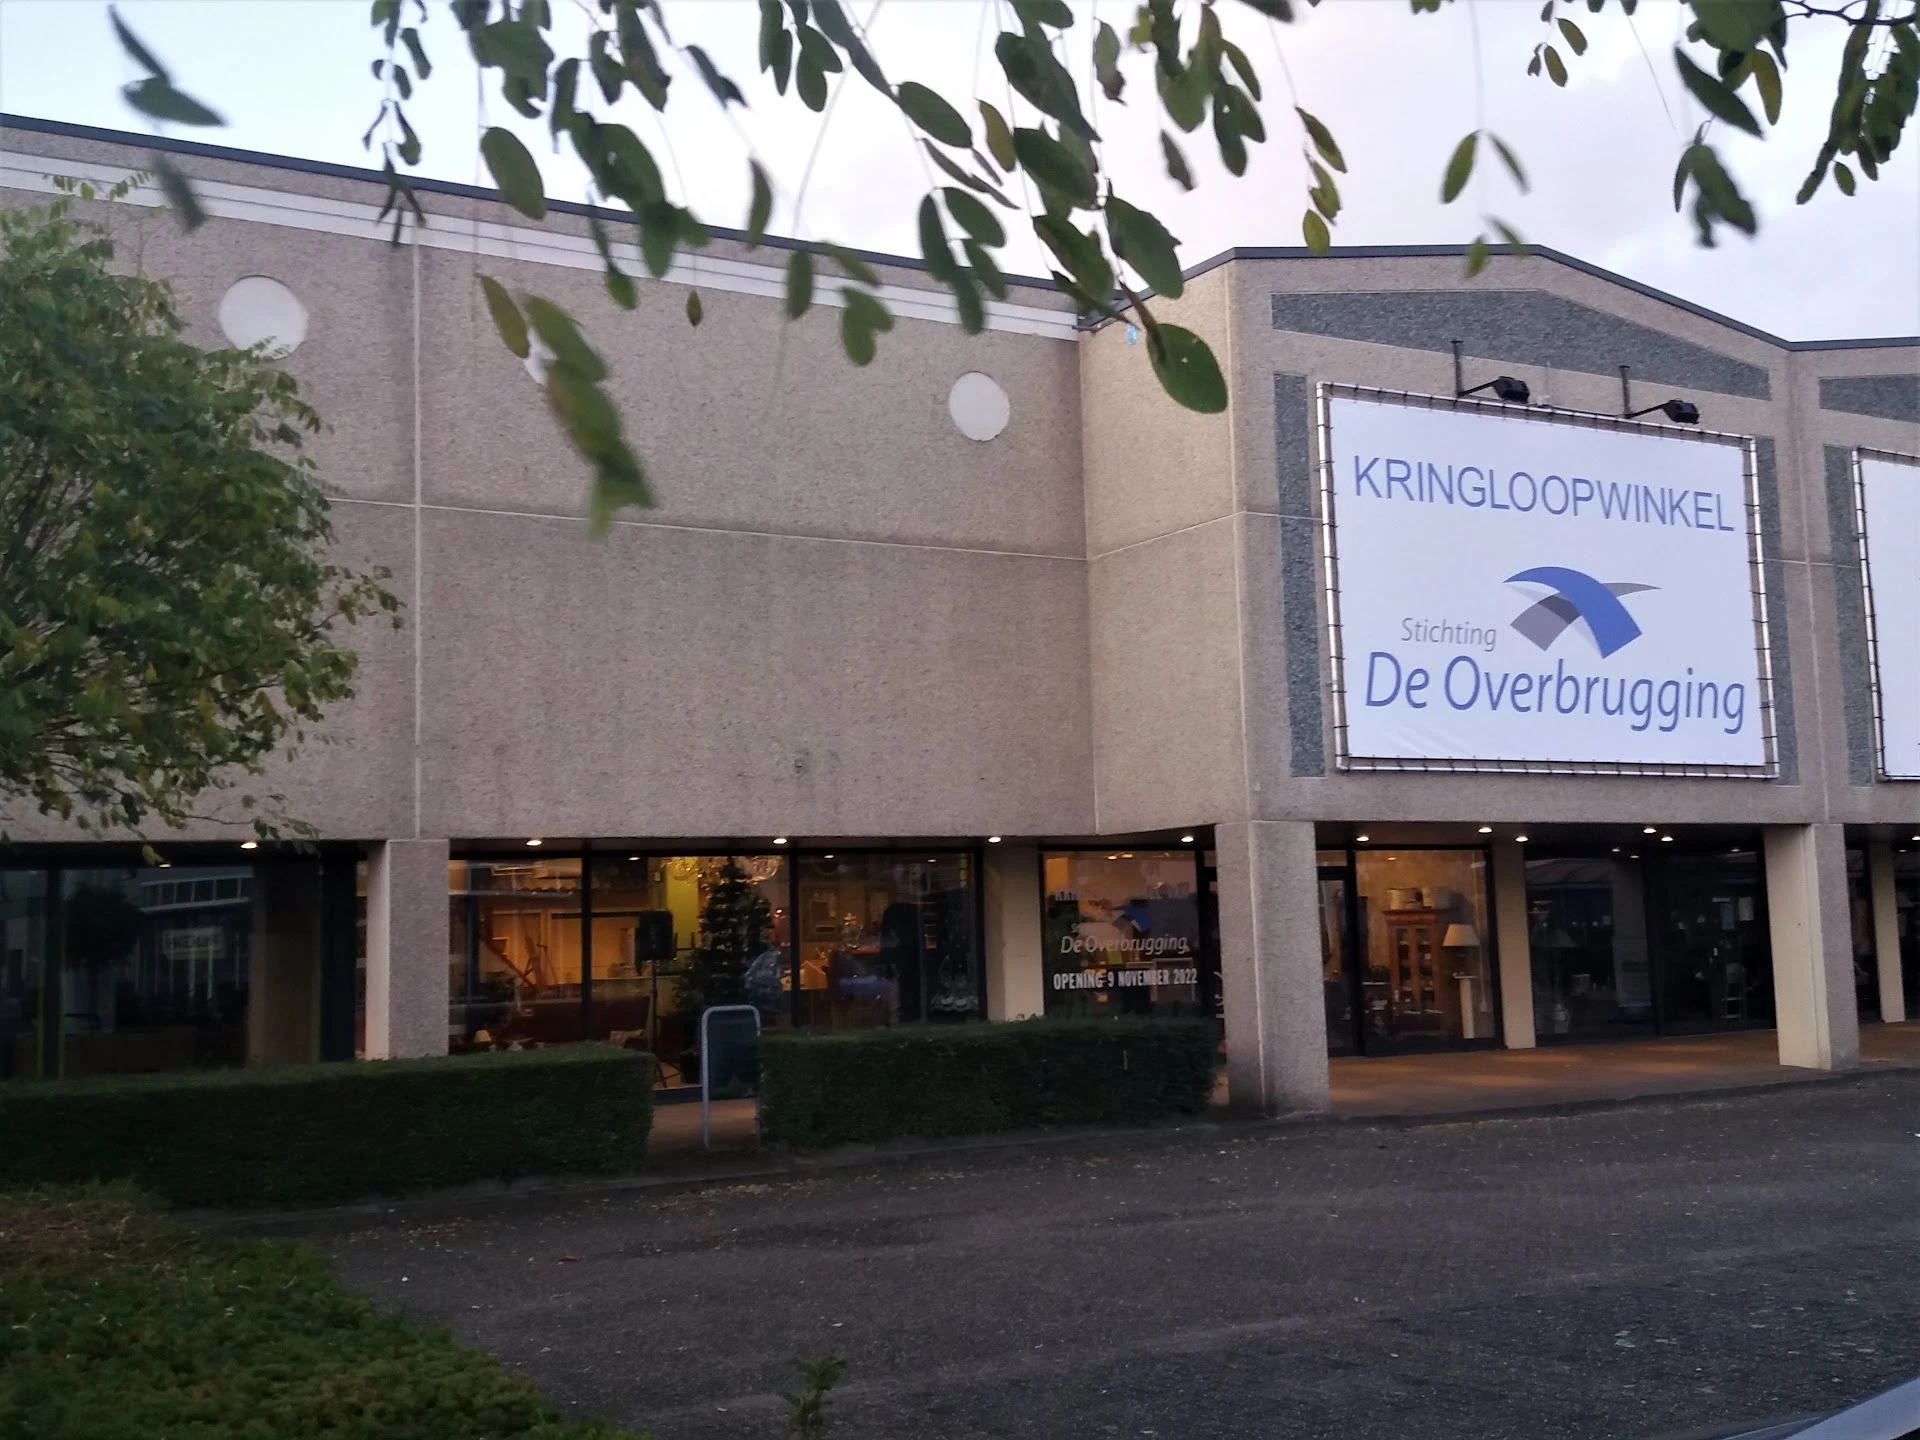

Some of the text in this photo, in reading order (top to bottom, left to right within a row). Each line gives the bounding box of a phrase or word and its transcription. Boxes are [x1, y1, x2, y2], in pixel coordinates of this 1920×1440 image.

[1354, 455, 1735, 531] KRINGLOOPWINKEL
[1401, 617, 1497, 653] Stichting
[1365, 651, 1745, 734] De Overbrugging
[1060, 935, 1081, 953] De
[1053, 970, 1106, 990] OPENING
[1117, 969, 1169, 988] NOVEMBER
[1173, 968, 1198, 985] 2022
